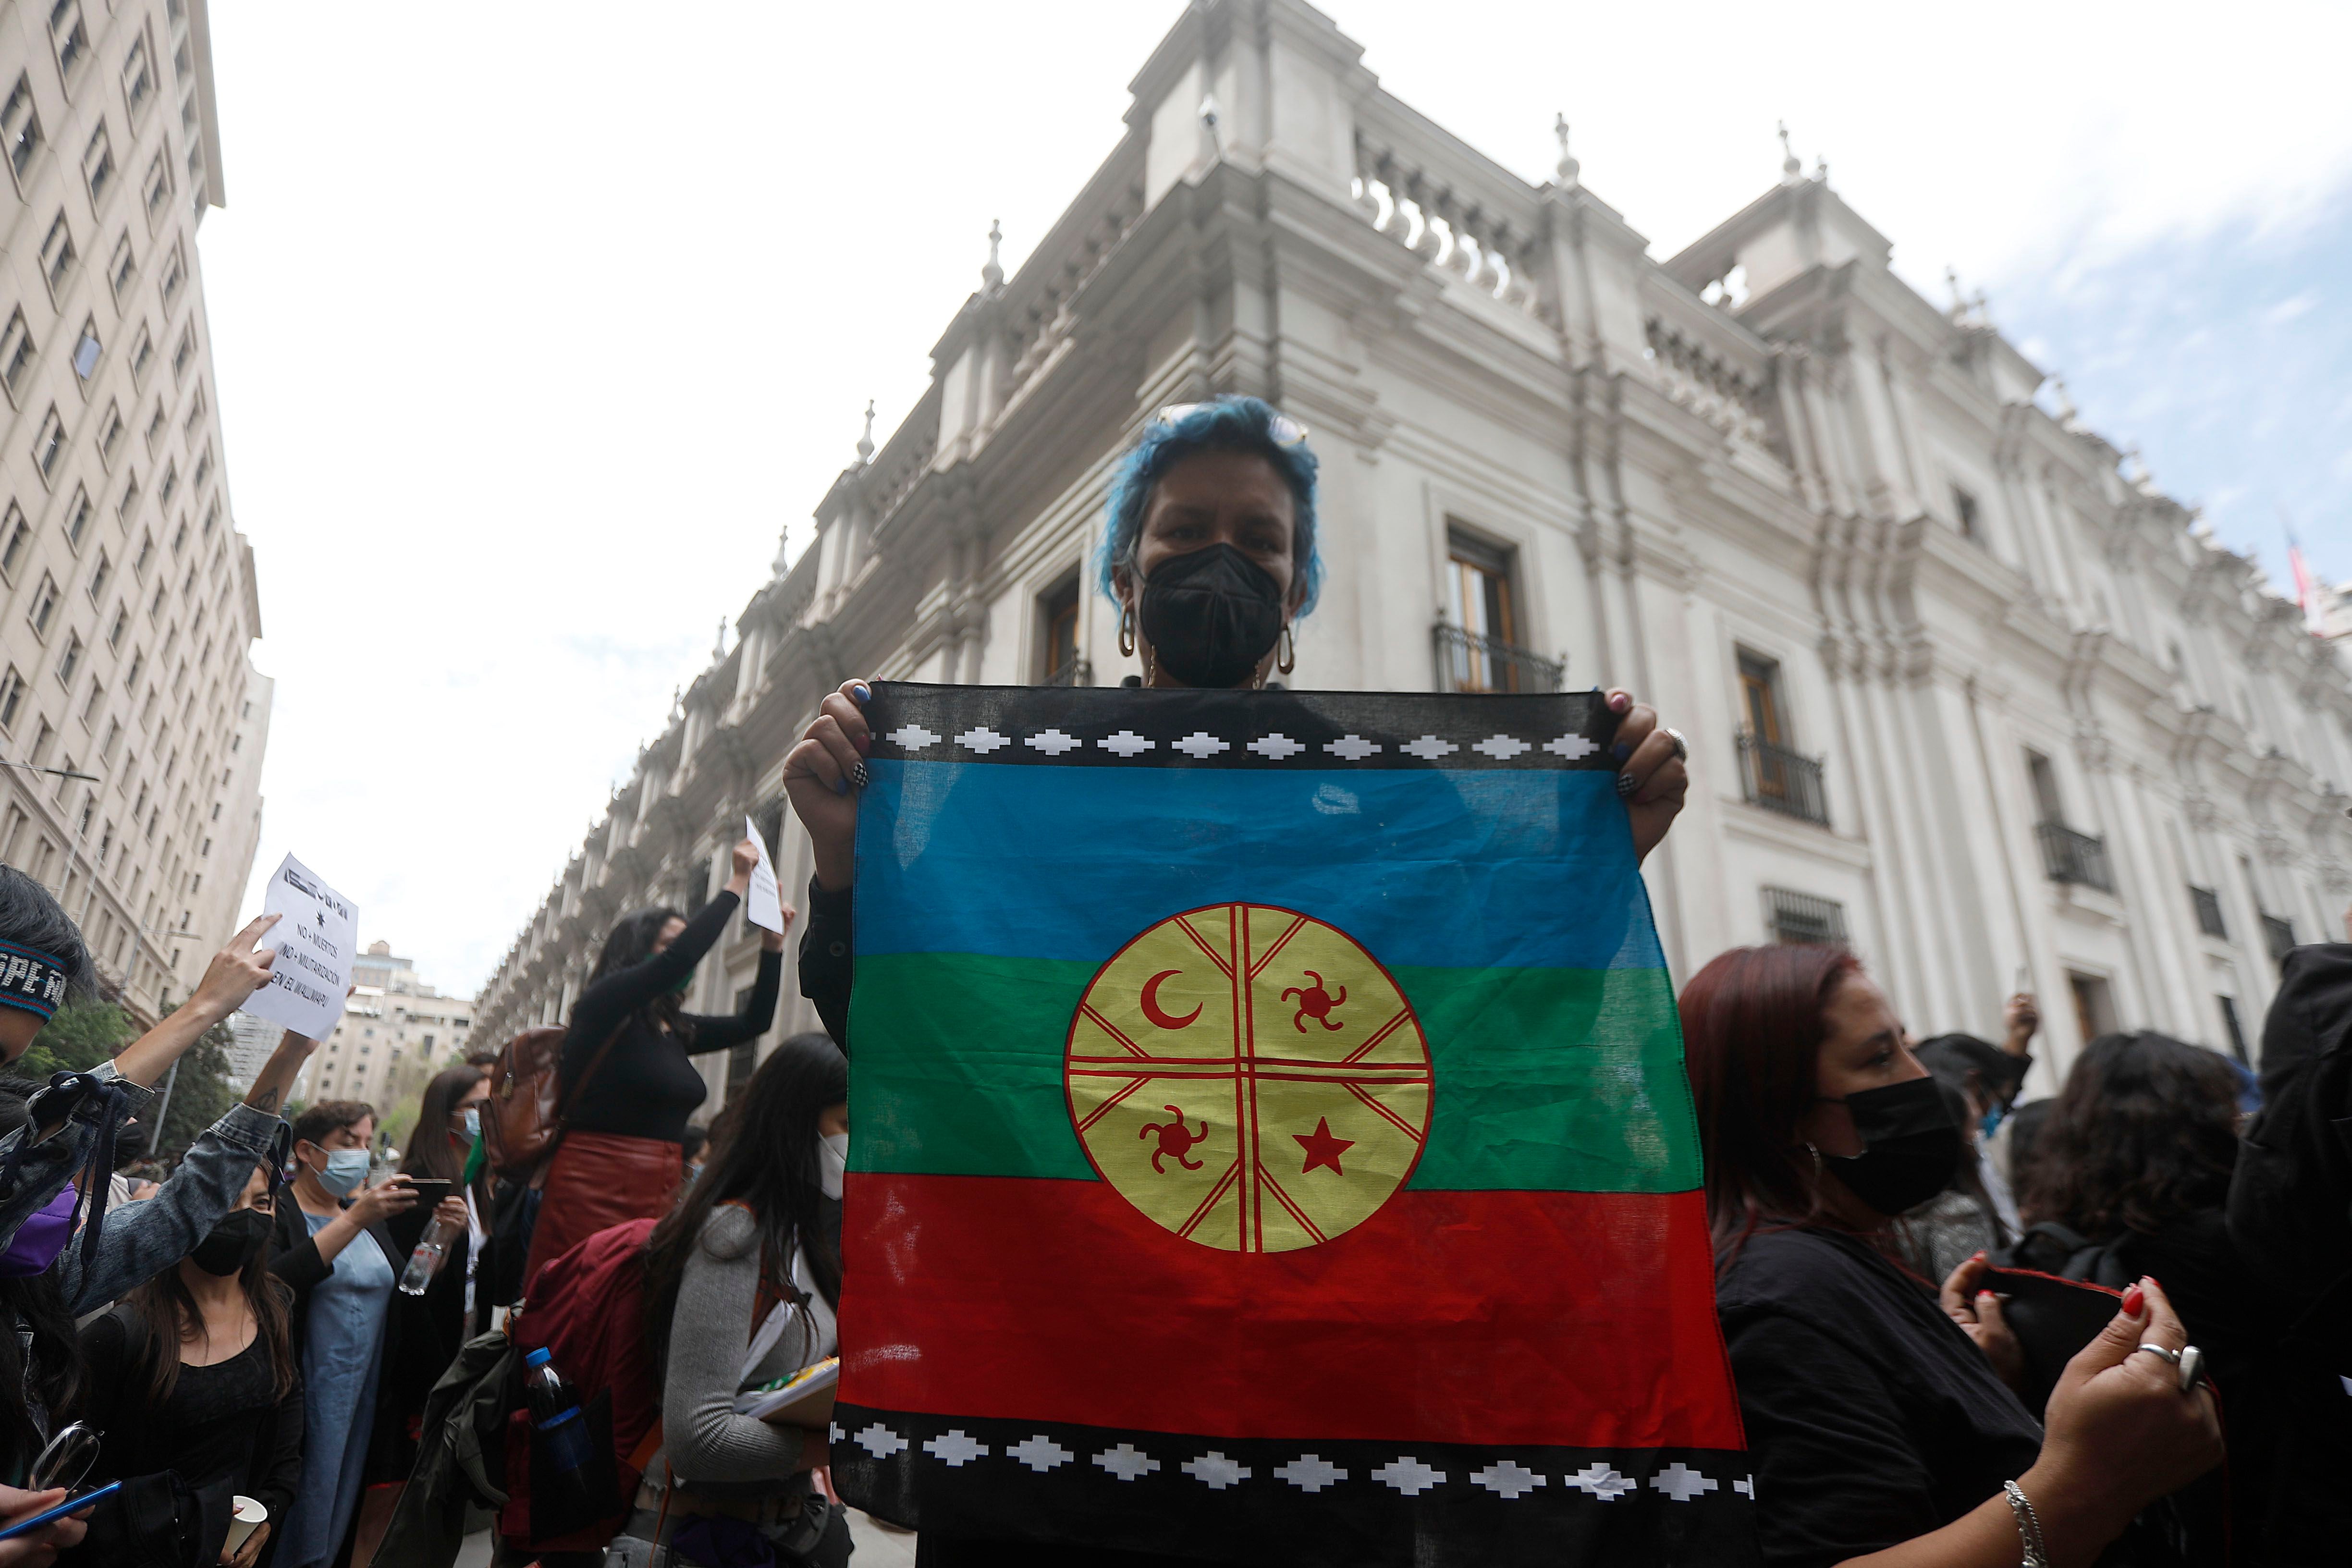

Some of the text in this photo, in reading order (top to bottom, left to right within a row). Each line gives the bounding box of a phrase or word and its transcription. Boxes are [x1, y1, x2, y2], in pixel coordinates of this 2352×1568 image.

[297, 923, 338, 959] NO + MUERTOS
[279, 942, 294, 959] NO
[298, 952, 341, 987] MILITARIZACIÓN
[270, 970, 330, 1007] EN EL WALLMAPU
